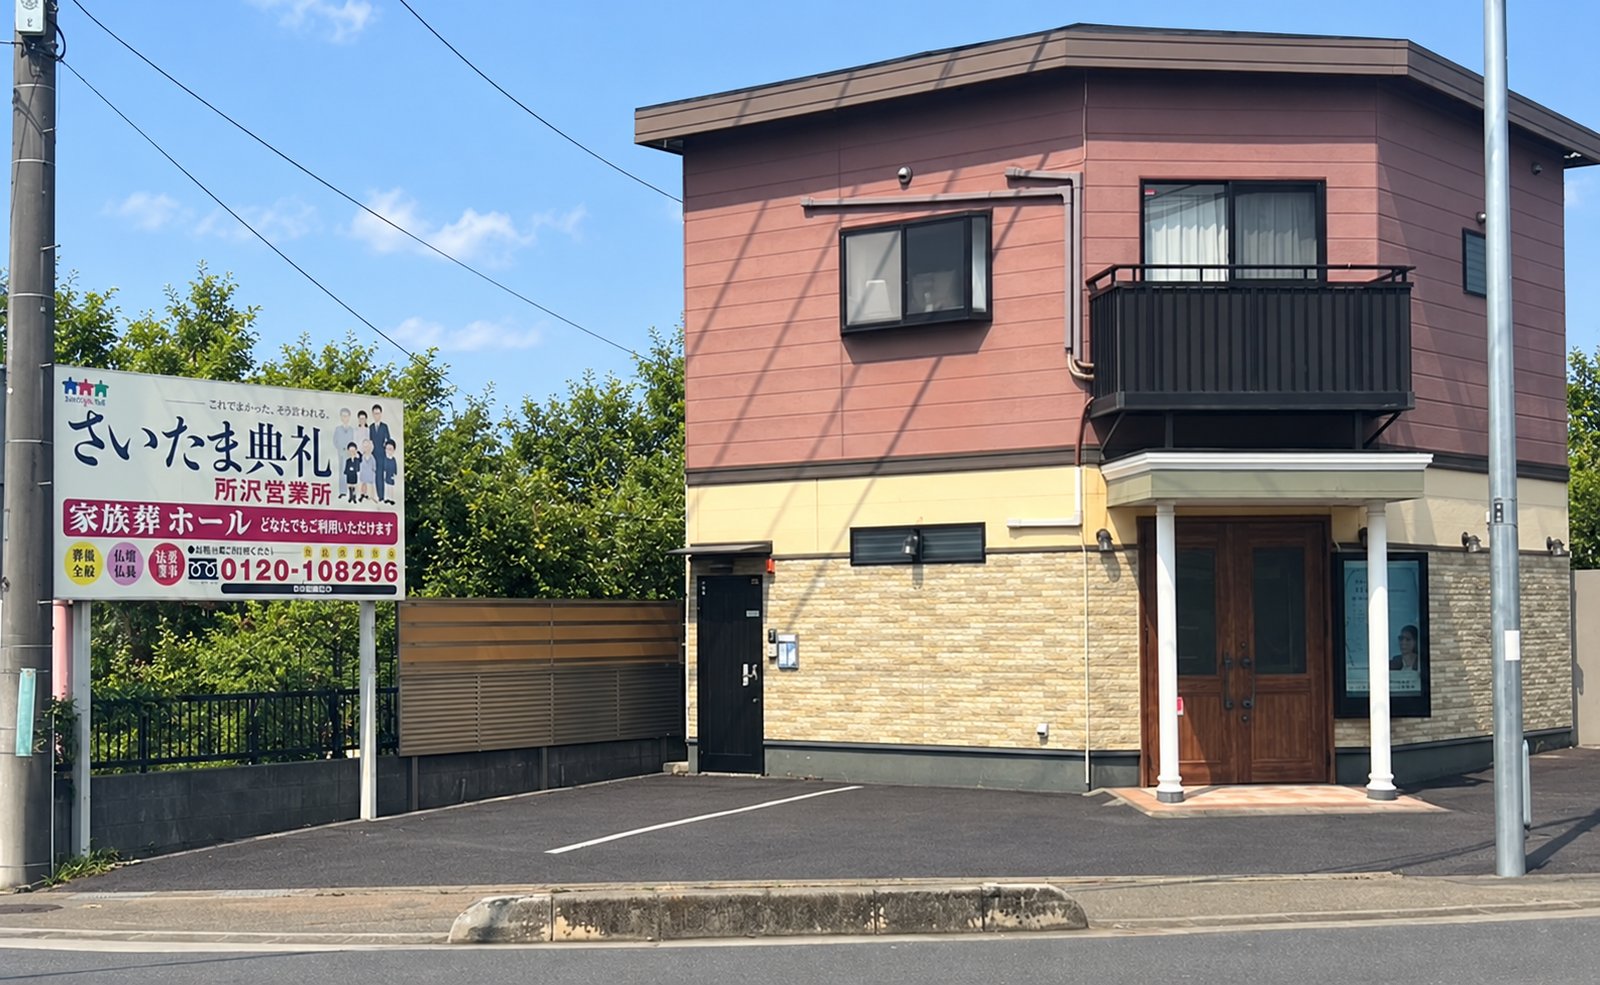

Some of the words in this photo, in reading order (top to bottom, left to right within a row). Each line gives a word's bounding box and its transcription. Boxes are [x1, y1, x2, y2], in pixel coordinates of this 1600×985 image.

[67, 409, 332, 478] さいたま典礼
[214, 477, 332, 506] 所沢営業所
[260, 516, 394, 537] どなたでもご利用いただけます
[114, 564, 136, 578] 仏具
[221, 557, 398, 583] 0120-108296
